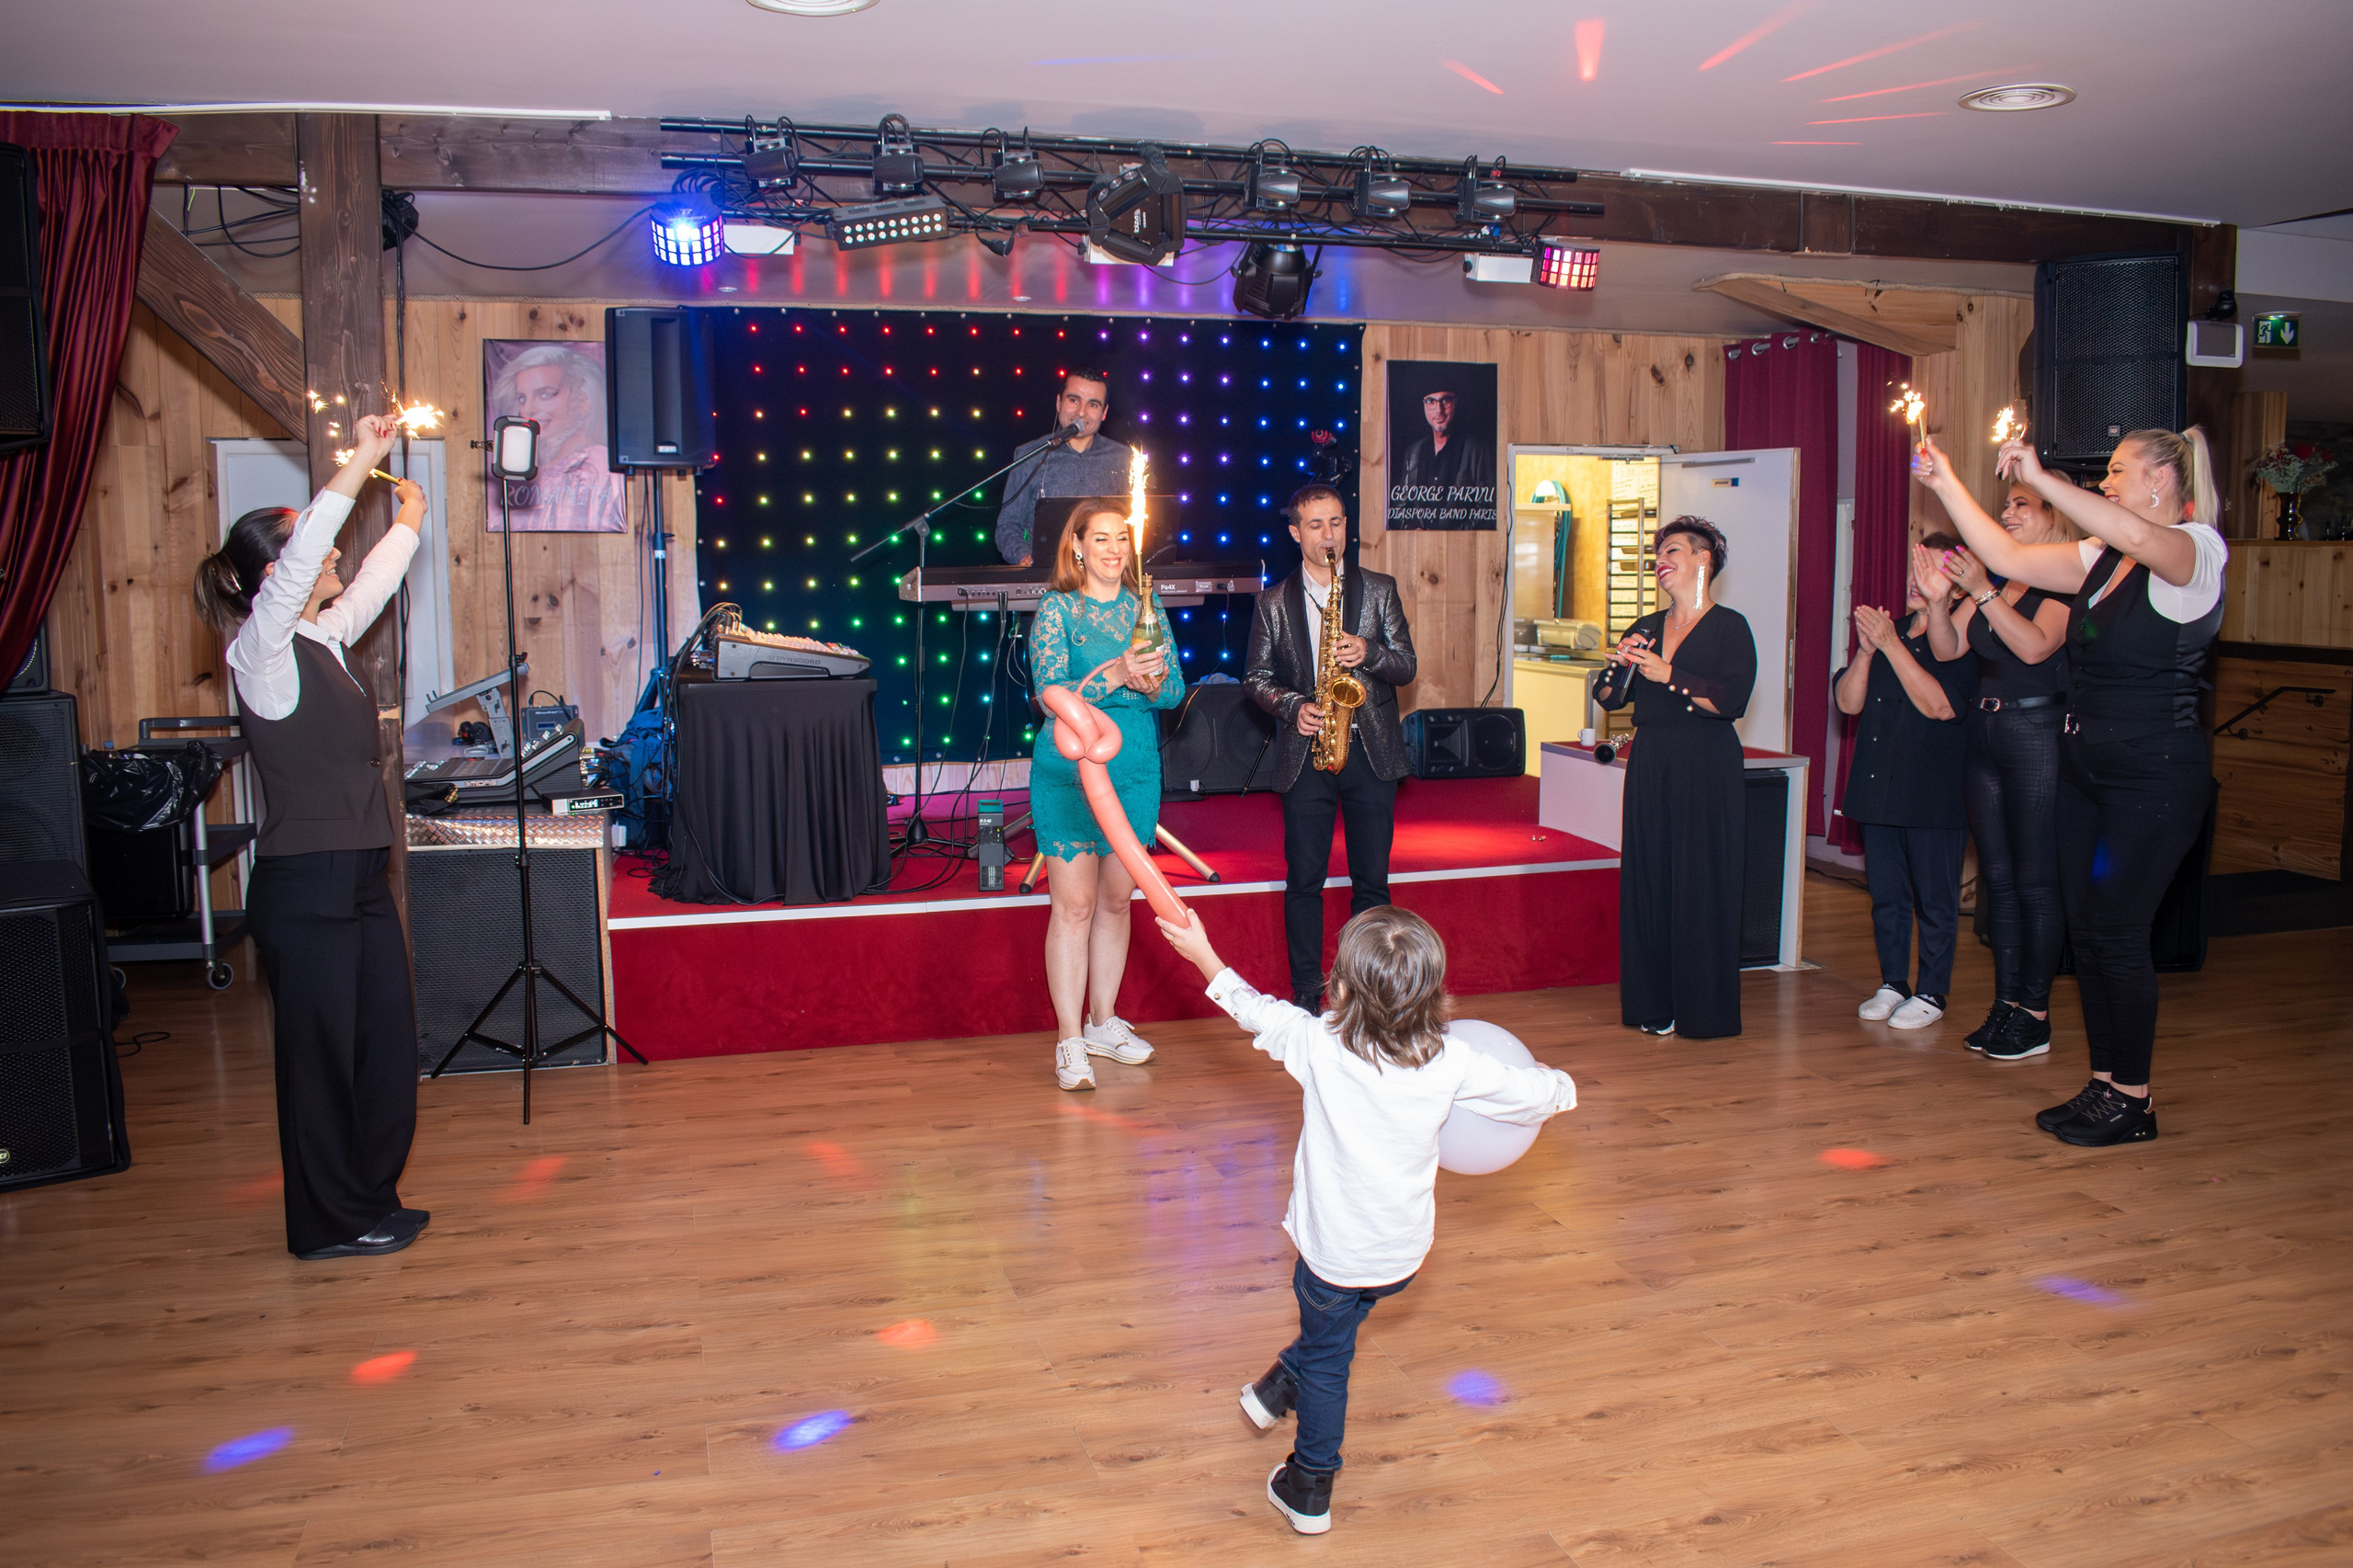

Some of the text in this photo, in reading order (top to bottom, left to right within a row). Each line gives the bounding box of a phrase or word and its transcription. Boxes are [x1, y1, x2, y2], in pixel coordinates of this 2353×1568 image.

[1391, 485, 1495, 502] GEORGE PARVU
[1387, 507, 1497, 520] DIASPORA BAND PARIS
